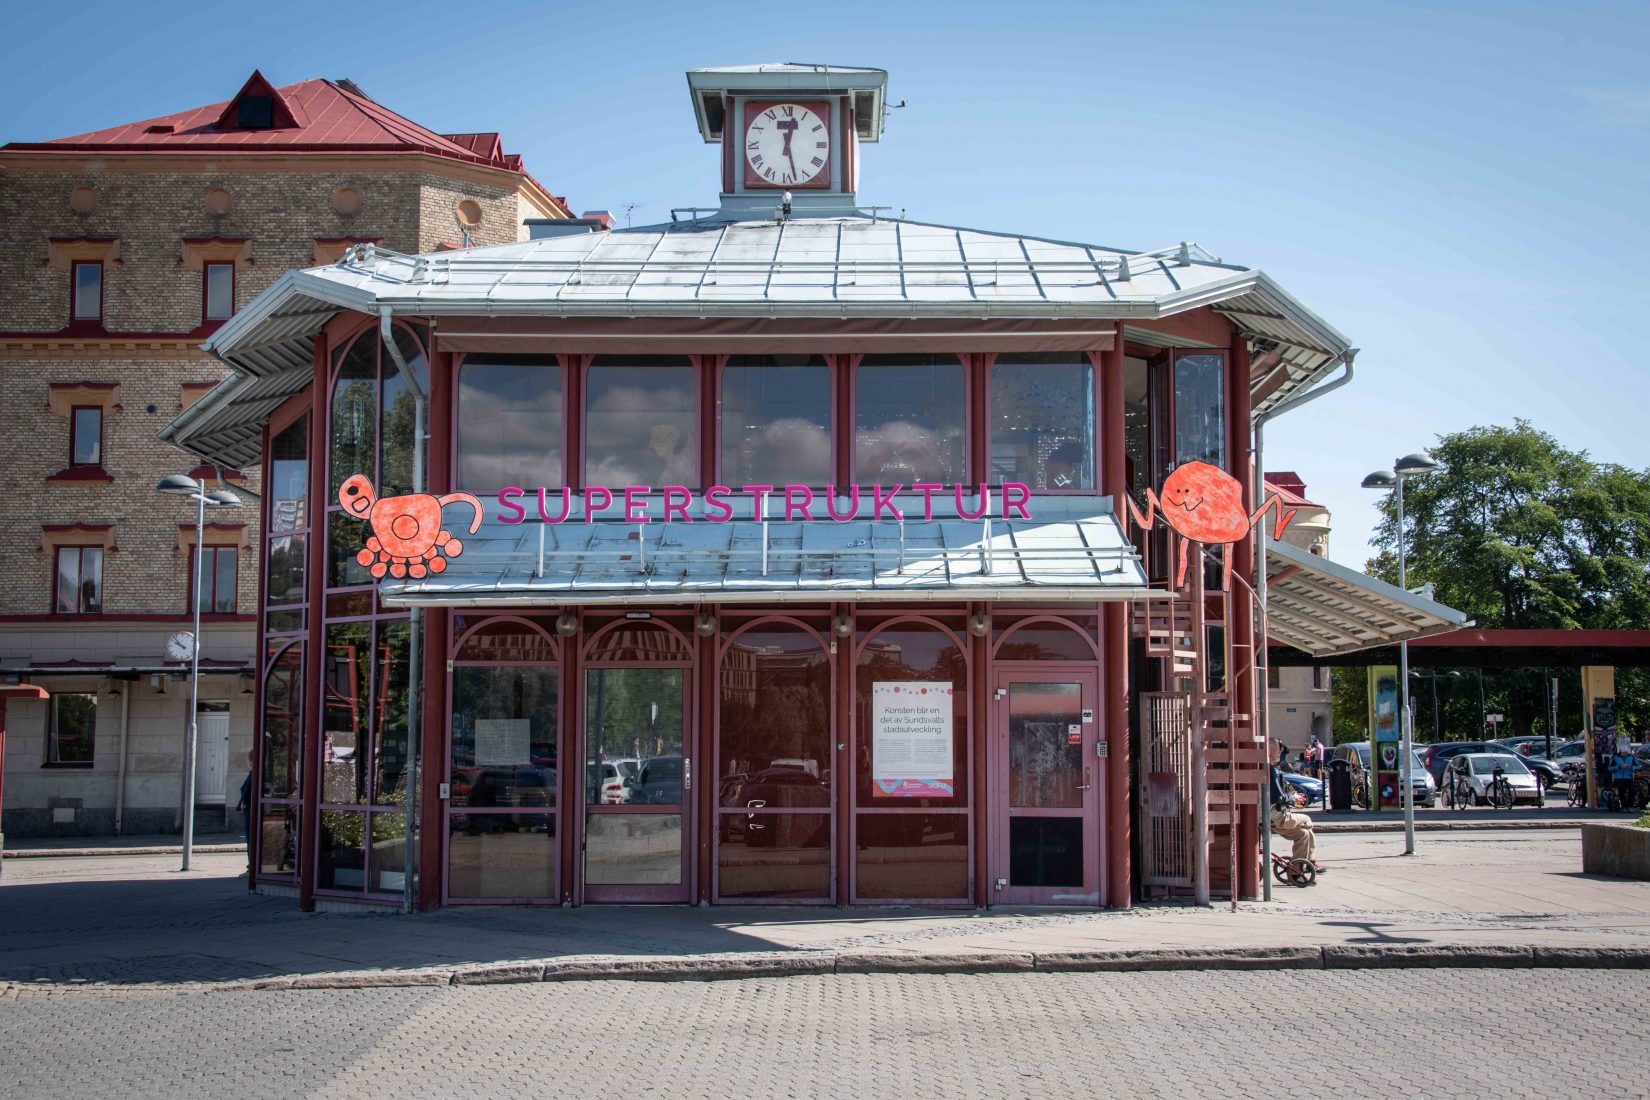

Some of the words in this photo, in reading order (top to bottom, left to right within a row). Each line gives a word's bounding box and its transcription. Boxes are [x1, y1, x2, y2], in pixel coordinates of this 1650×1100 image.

[764, 110, 776, 122] XI
[782, 106, 793, 117] XII
[801, 111, 808, 120] I
[752, 122, 764, 134] X
[812, 124, 823, 133] II
[748, 140, 760, 150] IX
[764, 168, 776, 180] VII
[782, 172, 792, 184] VI
[802, 170, 810, 180] V
[498, 482, 1033, 524] SUPERSTRUKTUR
[884, 706, 916, 714] Konsten
[916, 706, 928, 714] blir
[883, 726, 942, 734] stadsutveckling
